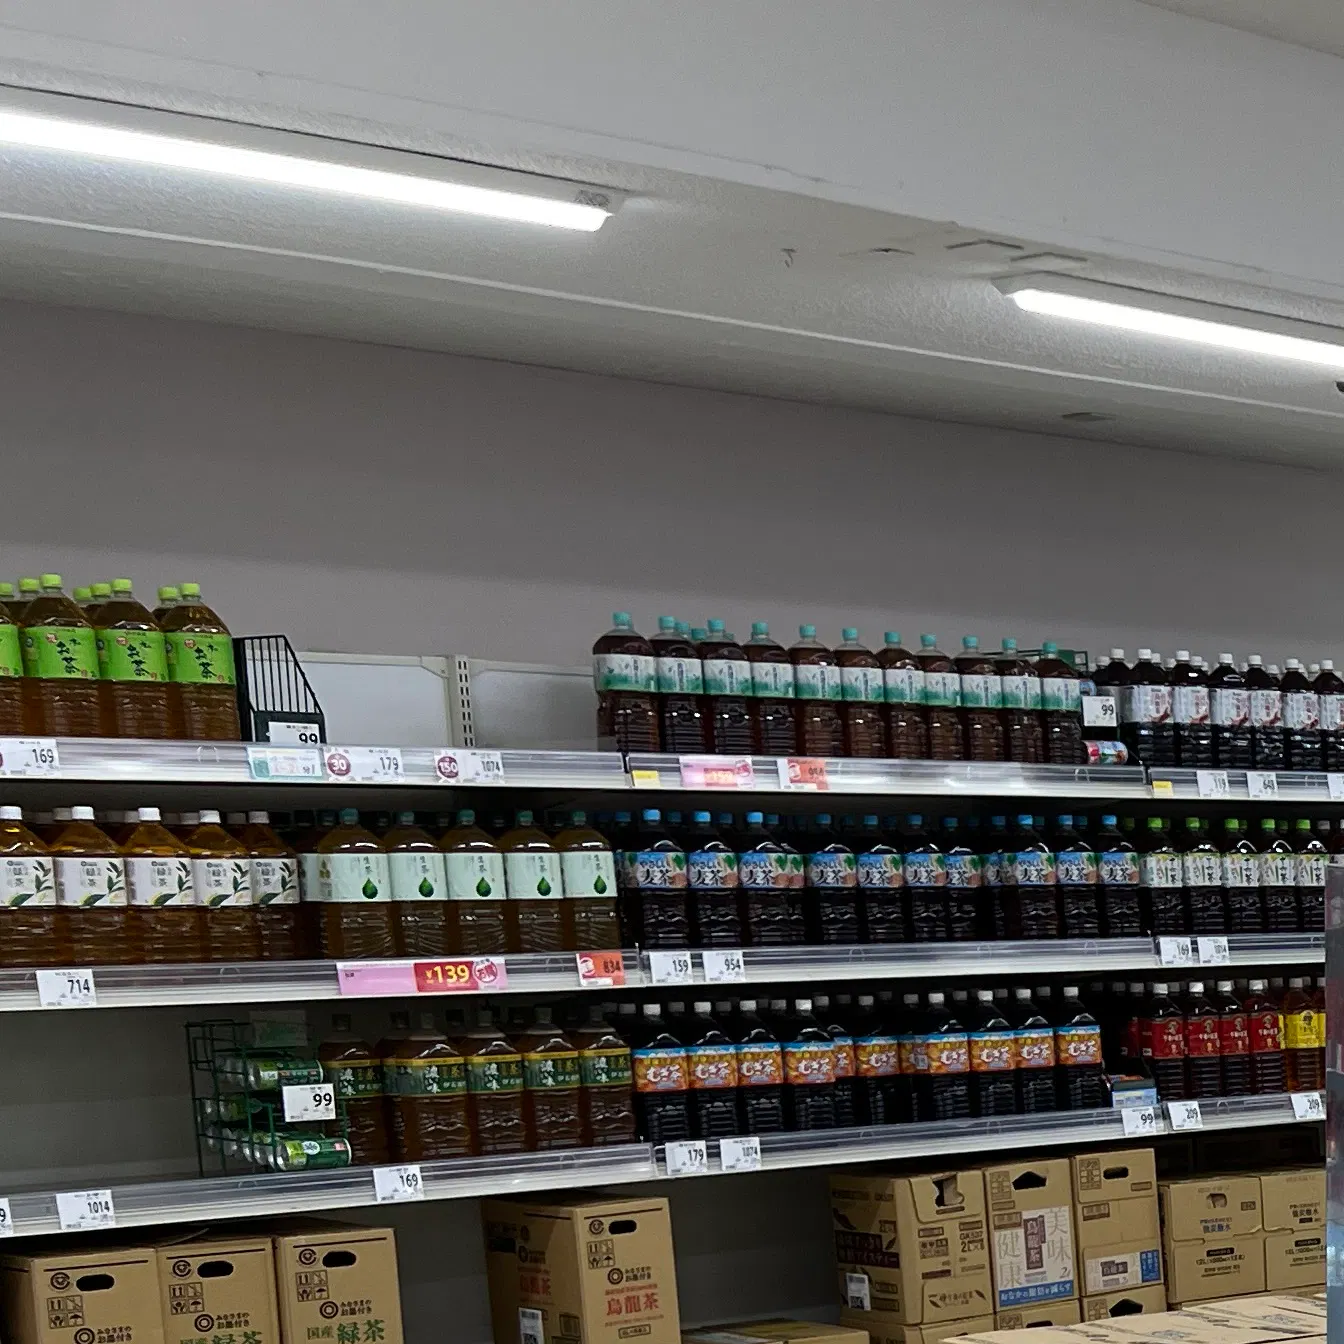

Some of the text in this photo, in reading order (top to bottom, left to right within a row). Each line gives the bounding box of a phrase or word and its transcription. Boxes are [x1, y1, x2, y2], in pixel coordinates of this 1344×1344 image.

[1101, 704, 1114, 716] 99
[32, 748, 54, 764] 169
[380, 756, 399, 770] 179
[331, 758, 347, 771] 30
[439, 759, 459, 773] 150
[672, 960, 689, 973] 159
[724, 959, 741, 972] 954
[67, 979, 90, 994] 714
[313, 1093, 332, 1107] 99
[1140, 1113, 1154, 1126] 99
[687, 1148, 704, 1162] 179
[400, 1173, 418, 1187] 169
[87, 1201, 110, 1214] 1014
[606, 1292, 659, 1316] 烏龍茶
